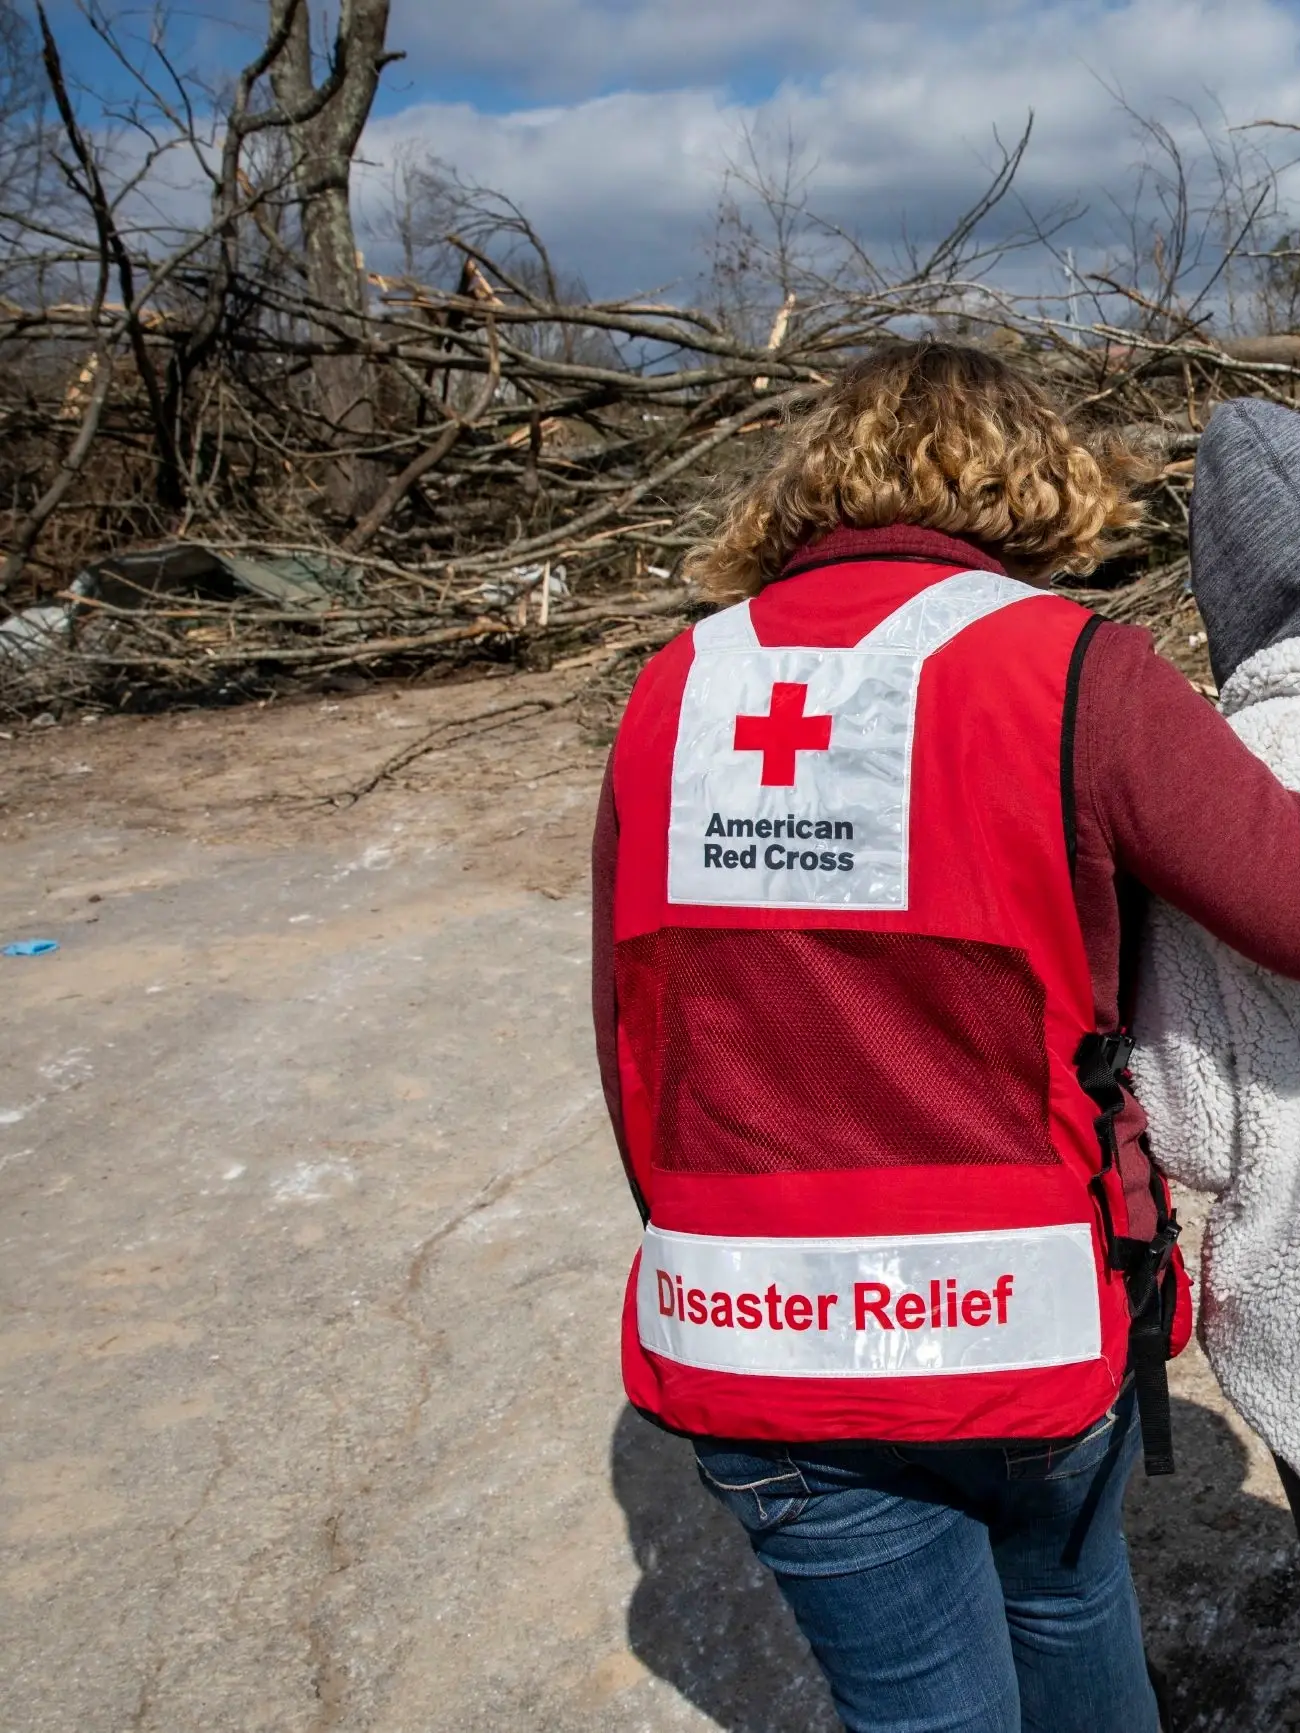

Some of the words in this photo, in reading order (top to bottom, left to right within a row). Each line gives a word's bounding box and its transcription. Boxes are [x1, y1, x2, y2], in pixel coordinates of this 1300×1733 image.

[704, 812, 854, 840] American
[704, 843, 757, 869] Red
[764, 843, 855, 871] Cross
[656, 1269, 838, 1331] Disaster
[854, 1274, 1014, 1331] Relief
